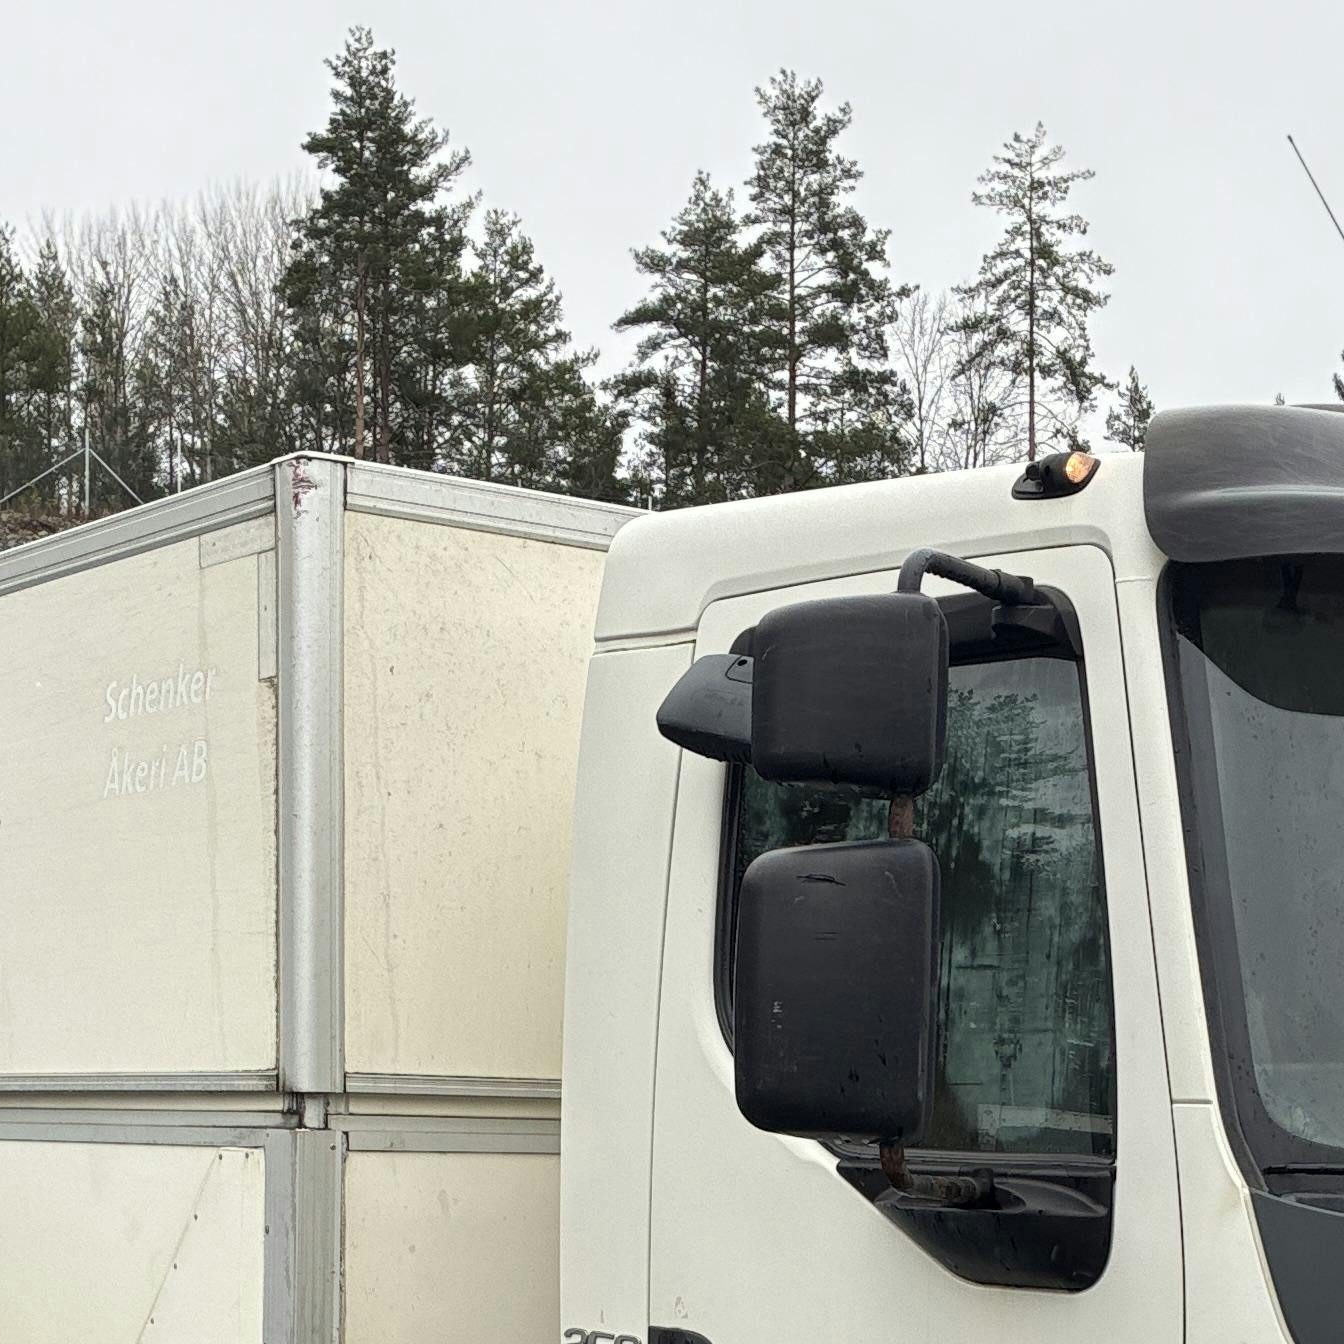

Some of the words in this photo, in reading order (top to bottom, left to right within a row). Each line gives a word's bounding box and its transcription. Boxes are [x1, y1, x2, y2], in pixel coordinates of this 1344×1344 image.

[104, 663, 216, 723] Schenker
[104, 745, 167, 799] Åkeri
[172, 739, 208, 785] AB
